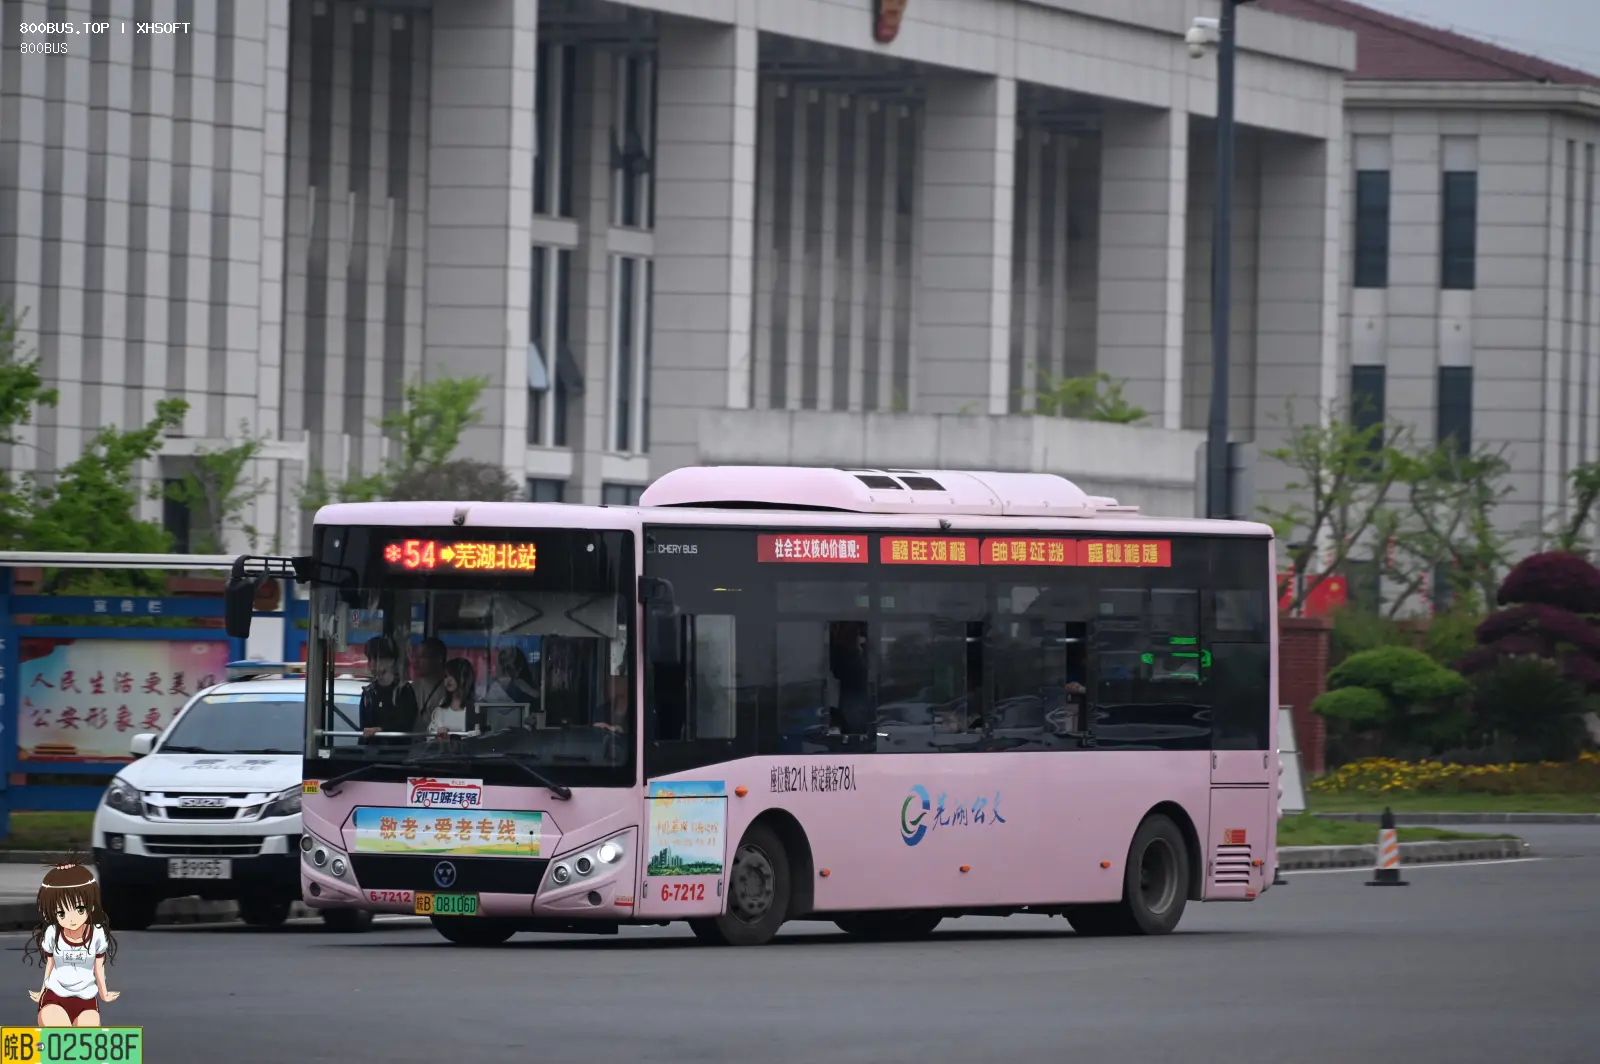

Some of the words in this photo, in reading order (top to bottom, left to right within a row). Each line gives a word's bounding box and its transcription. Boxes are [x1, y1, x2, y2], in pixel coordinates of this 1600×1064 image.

[403, 540, 436, 568] 54
[454, 543, 537, 569] 芜湖北站
[658, 544, 682, 554] CHERY
[683, 545, 698, 554] BUS
[31, 704, 183, 732] 公安形象更
[369, 890, 412, 903] 6-7212
[661, 883, 705, 901] 6-7212
